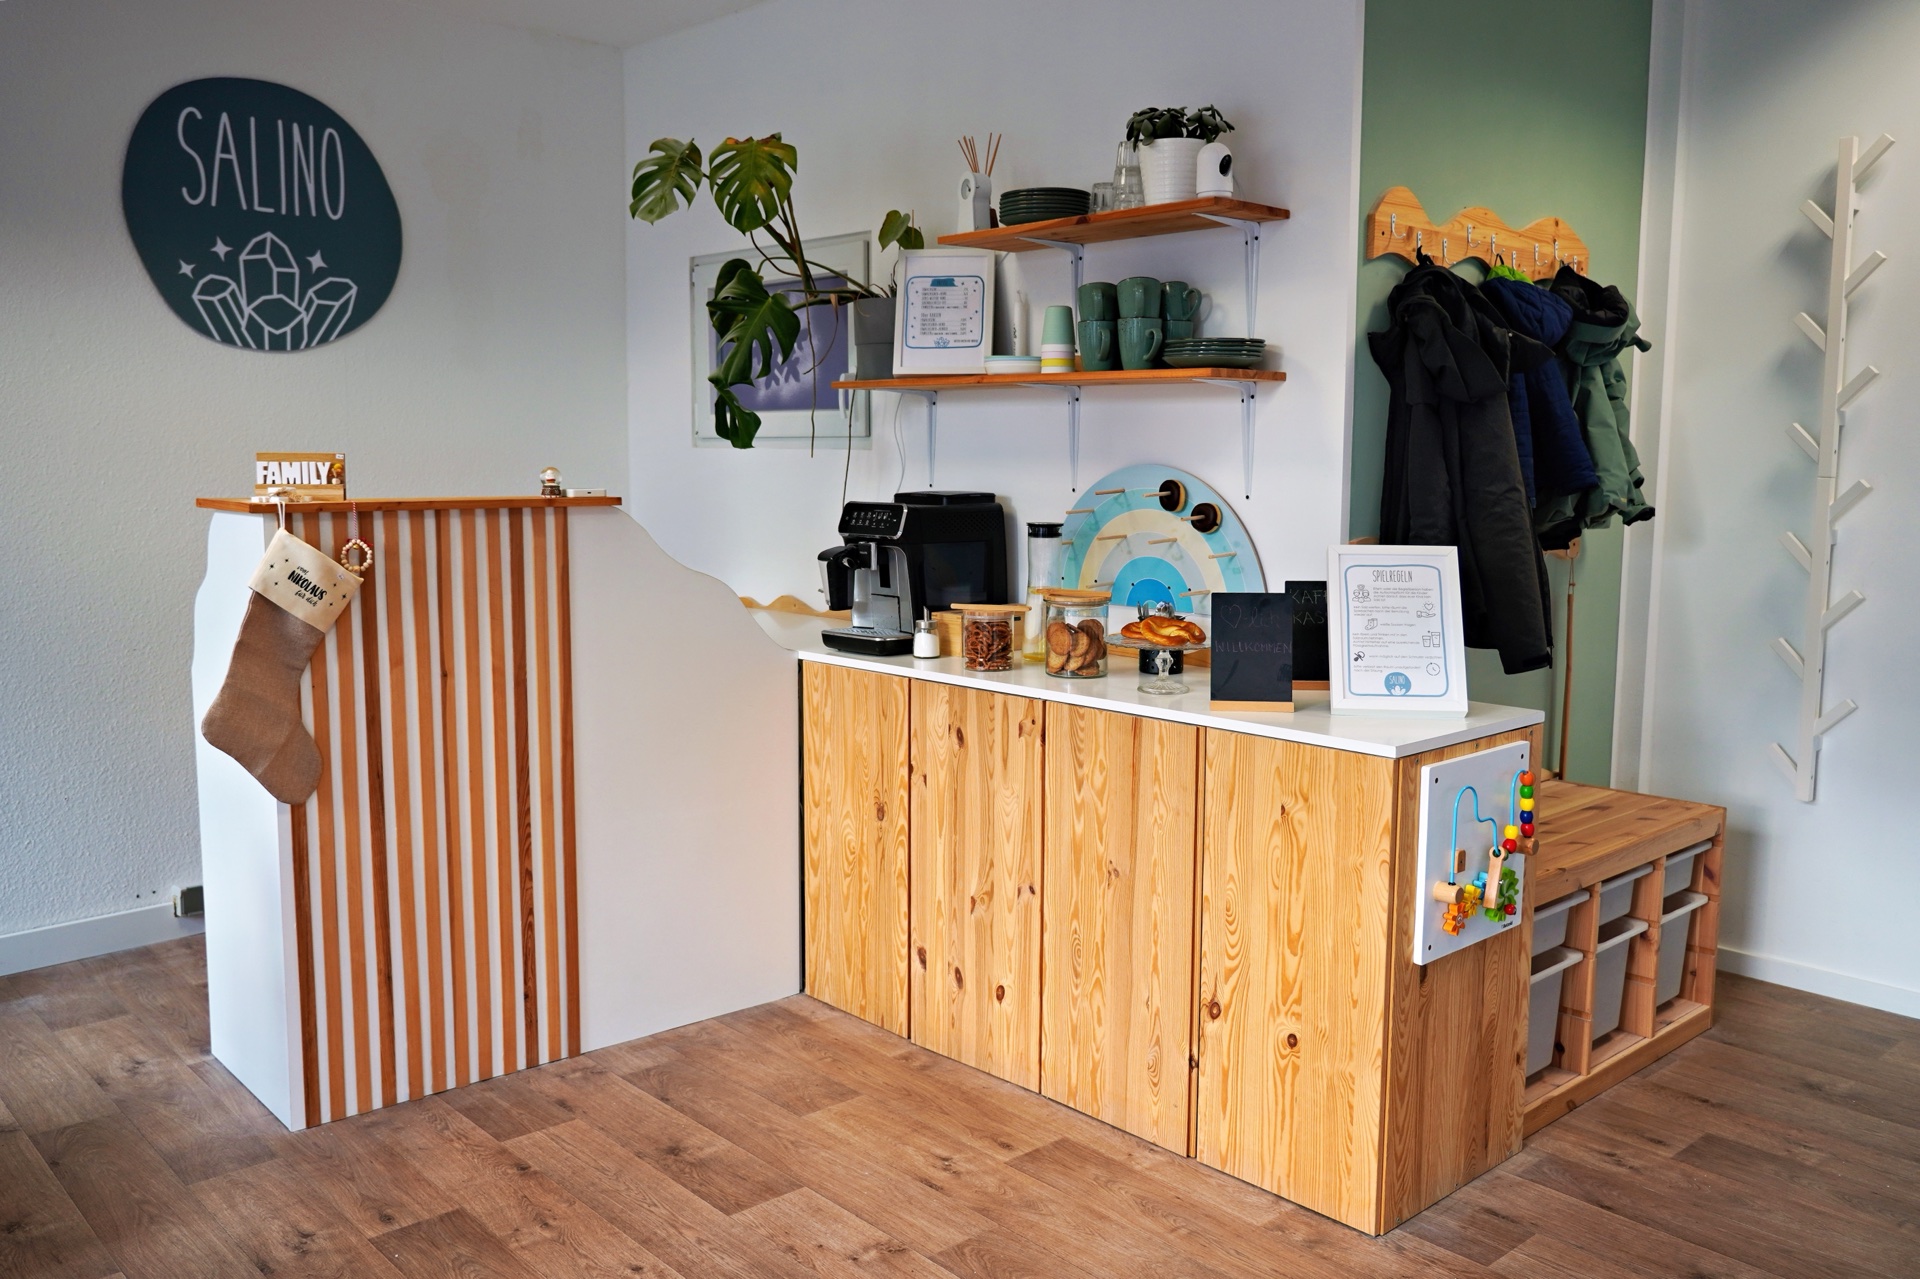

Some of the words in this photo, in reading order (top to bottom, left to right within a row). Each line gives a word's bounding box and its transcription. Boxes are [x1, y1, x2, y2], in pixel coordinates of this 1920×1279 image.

[176, 105, 345, 220] SALINO
[255, 460, 331, 485] FAMILY
[1372, 569, 1413, 583] SPIELREGELN
[287, 569, 328, 601] NIKOLAUS
[1292, 610, 1327, 626] KAS
[1215, 640, 1292, 654] WILLKOMMEN
[1388, 675, 1406, 685] SALINO
